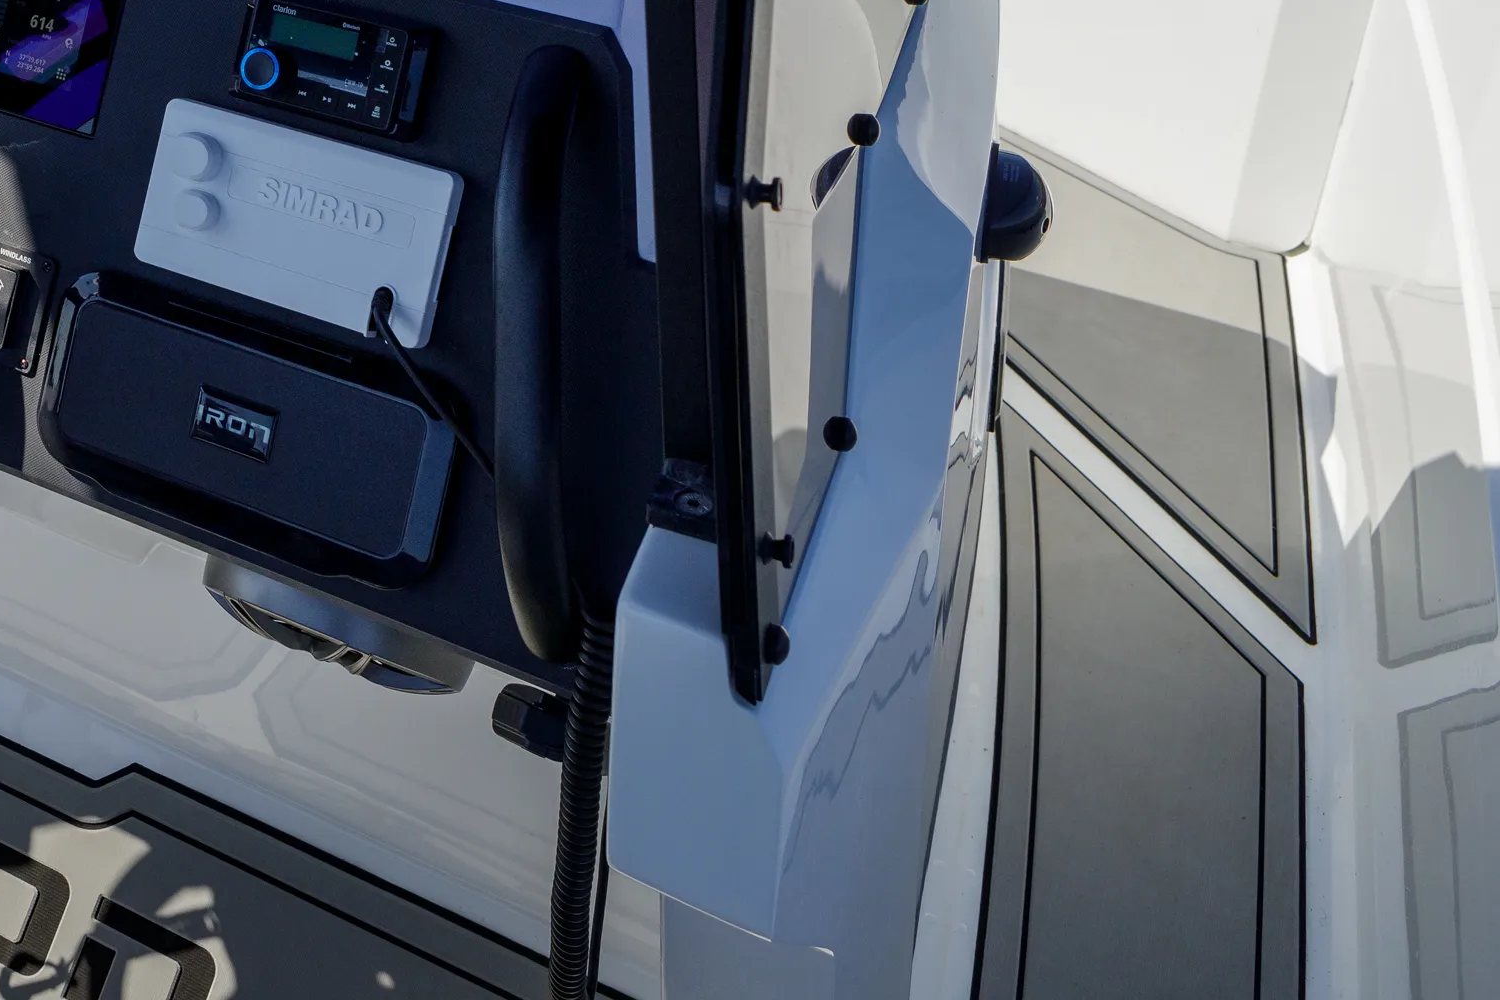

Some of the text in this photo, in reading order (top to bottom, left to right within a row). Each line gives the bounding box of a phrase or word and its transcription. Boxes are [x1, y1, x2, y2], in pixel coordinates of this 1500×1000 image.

[272, 4, 297, 16] clarion
[29, 14, 55, 33] 614
[5, 49, 11, 57] N
[258, 176, 385, 234] SIMRAD
[0, 247, 32, 264] WINDLASS
[196, 404, 271, 444] IRON
